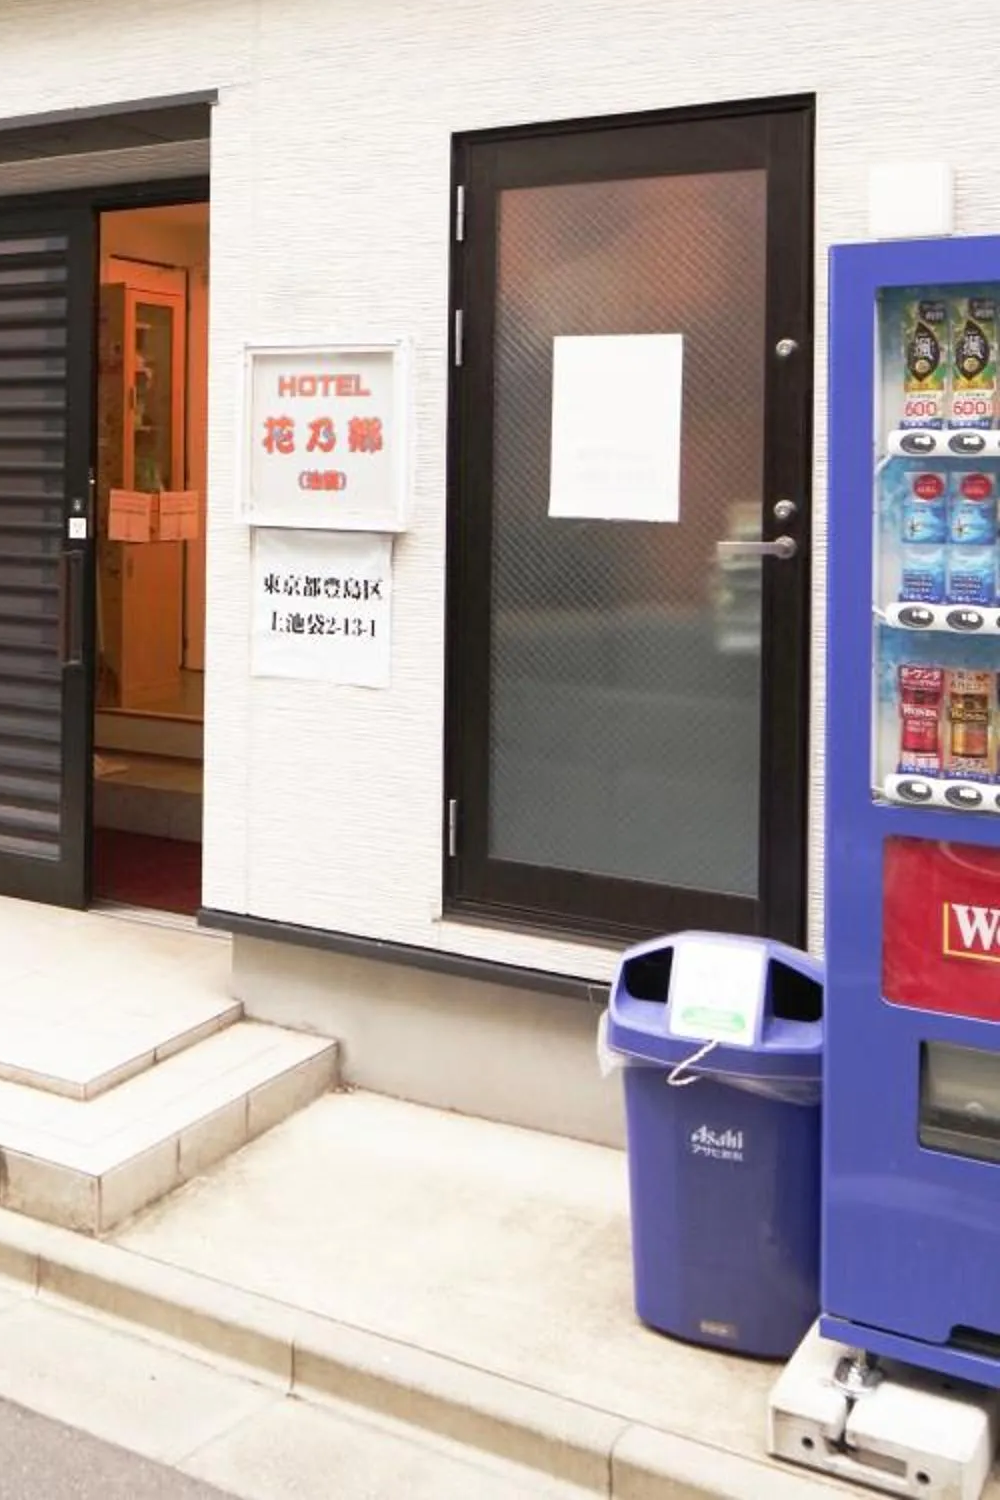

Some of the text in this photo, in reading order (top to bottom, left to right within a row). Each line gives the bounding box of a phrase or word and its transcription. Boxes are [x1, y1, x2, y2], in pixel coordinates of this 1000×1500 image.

[278, 374, 371, 397] HOTEL
[262, 416, 383, 454] 花乃郷
[263, 573, 384, 601] 東京都豊島区
[271, 611, 376, 638] 上池袋2-13-1
[951, 903, 1000, 951] W
[691, 1124, 743, 1150] Asahi
